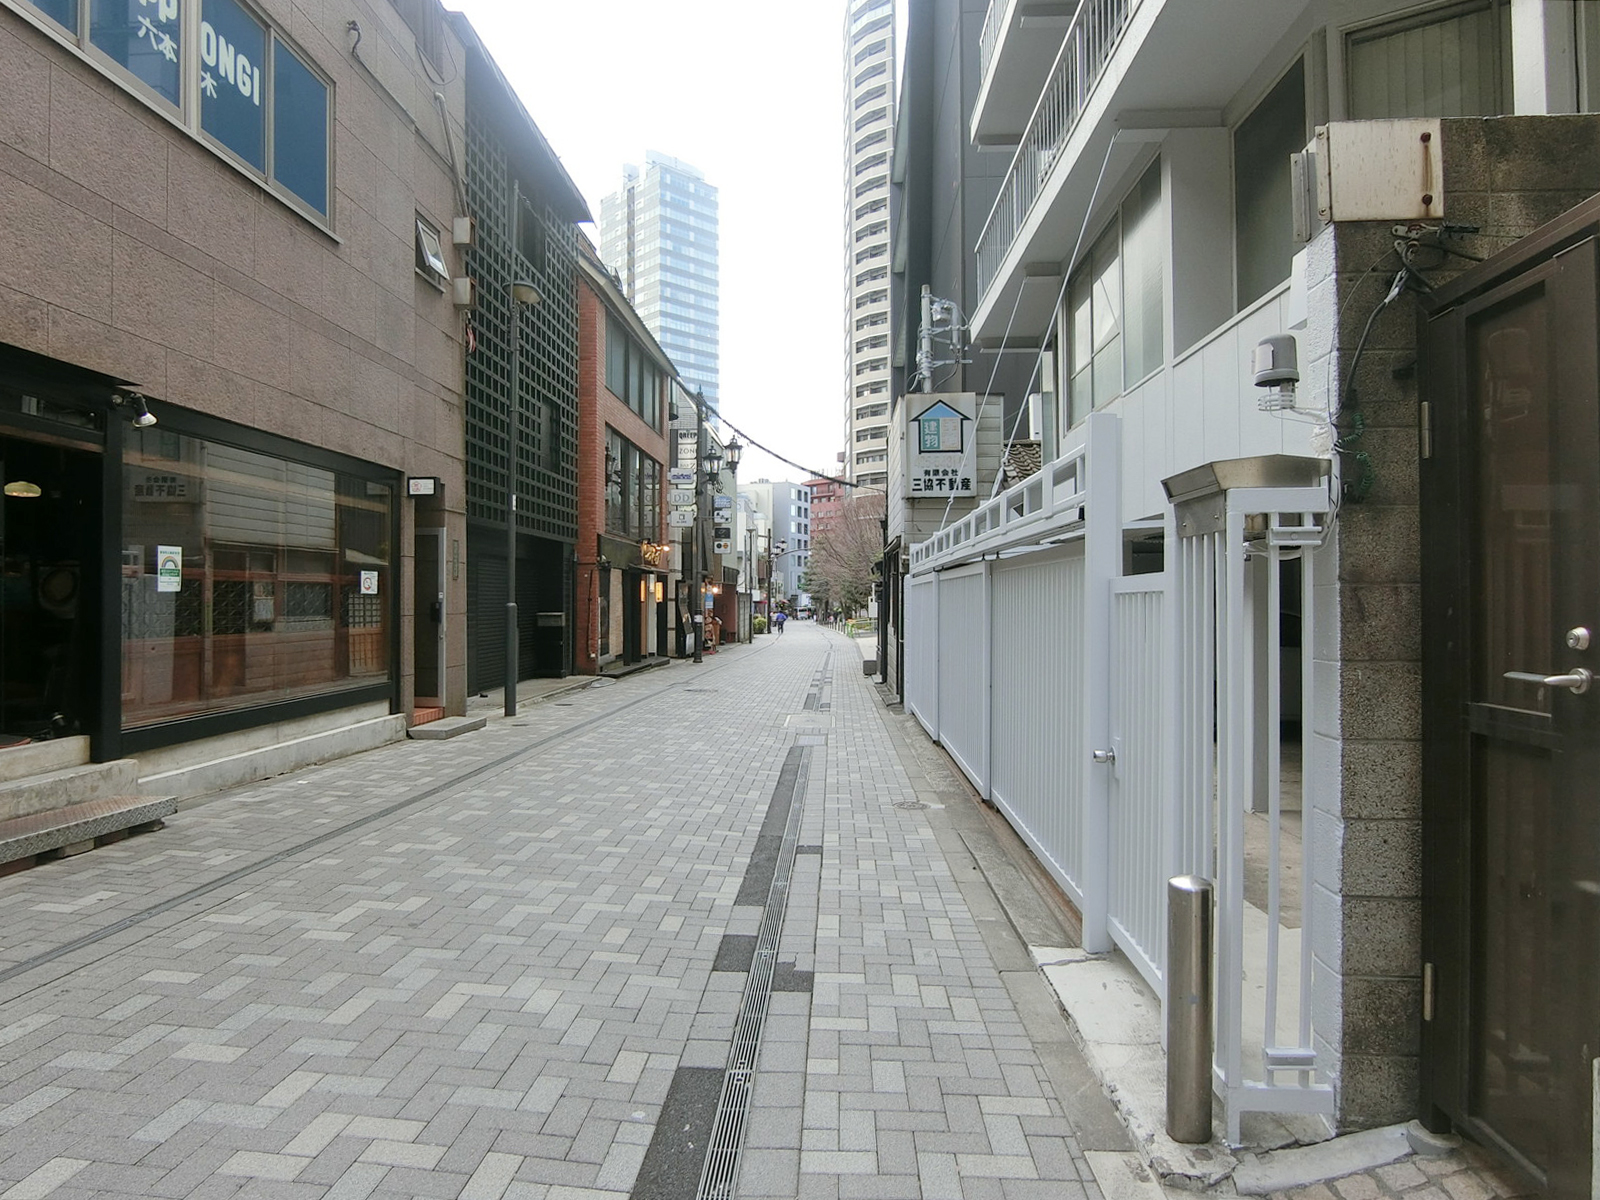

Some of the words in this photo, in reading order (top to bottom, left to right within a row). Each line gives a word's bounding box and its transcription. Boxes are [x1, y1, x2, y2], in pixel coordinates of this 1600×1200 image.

[201, 21, 260, 106] ONGI
[923, 420, 938, 448] 建物
[923, 468, 959, 477] 有限会社
[912, 477, 972, 492] 三協不動産
